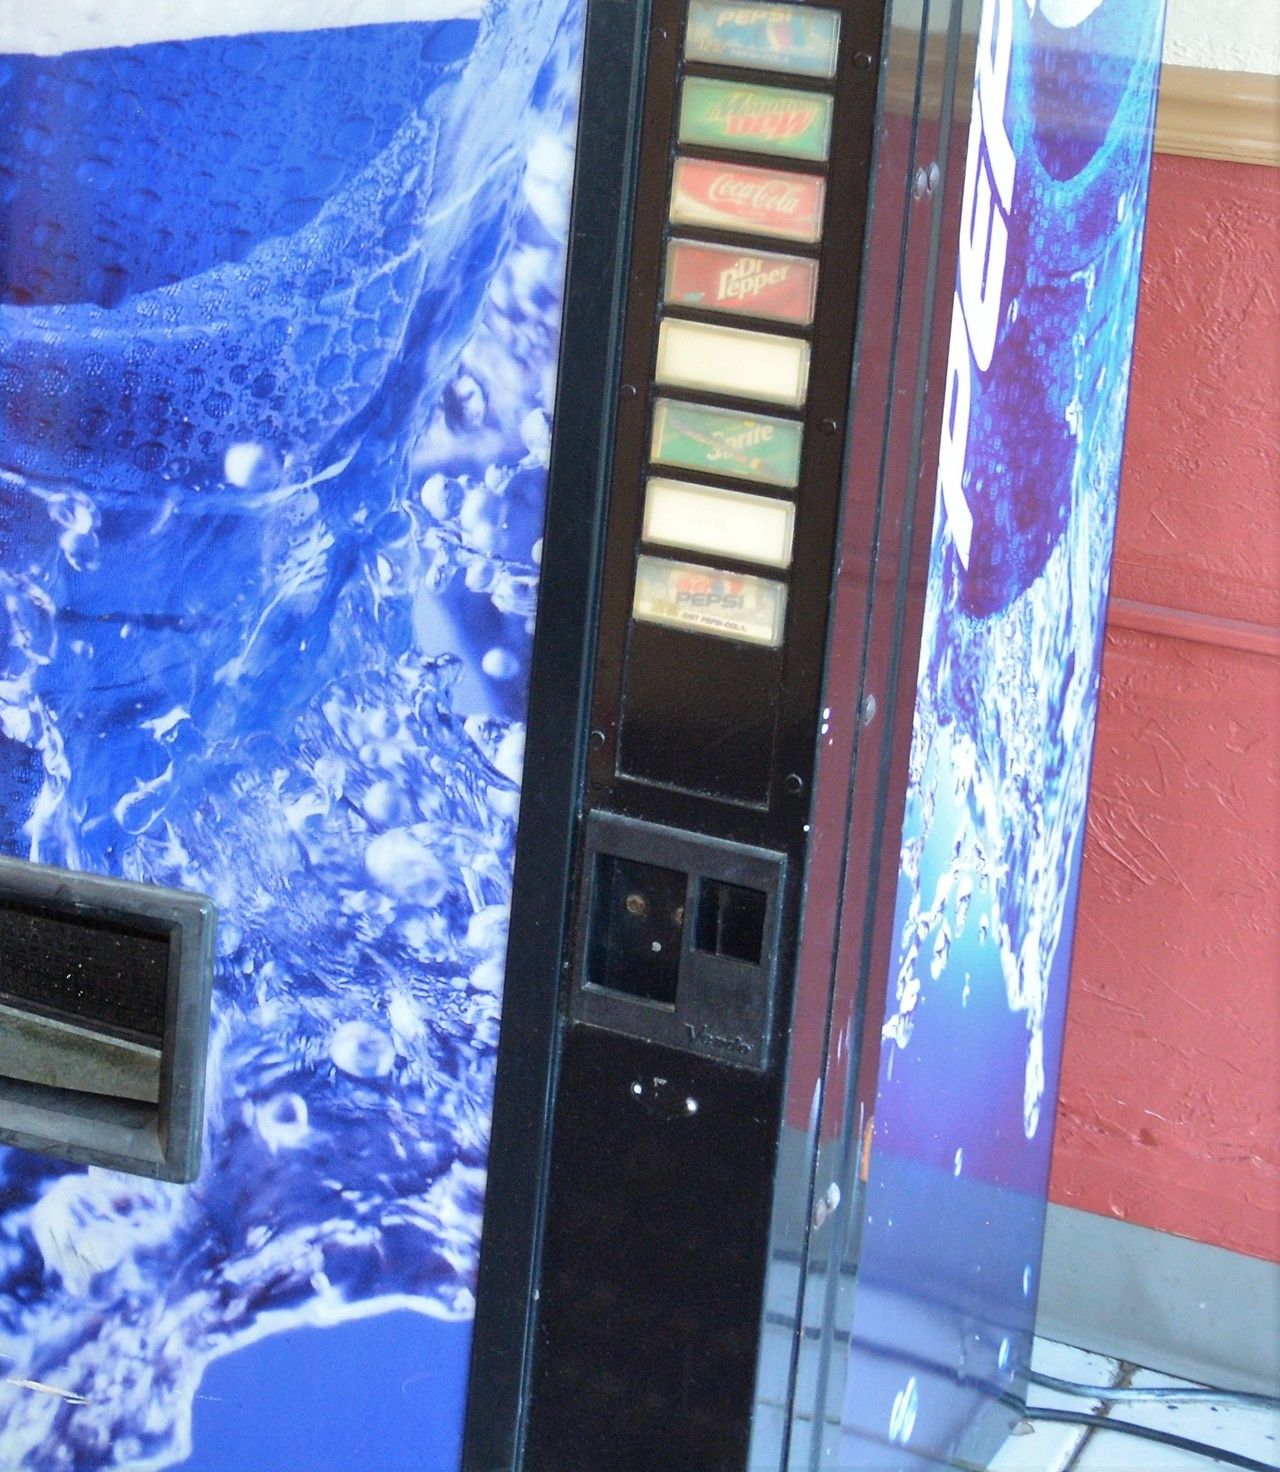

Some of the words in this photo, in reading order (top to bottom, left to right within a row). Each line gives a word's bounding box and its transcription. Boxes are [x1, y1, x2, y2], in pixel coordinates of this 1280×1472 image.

[708, 173, 801, 214] Coca-Cola
[736, 256, 764, 275] Dr
[716, 264, 790, 301] Pepper
[675, 591, 745, 619] PEPSI
